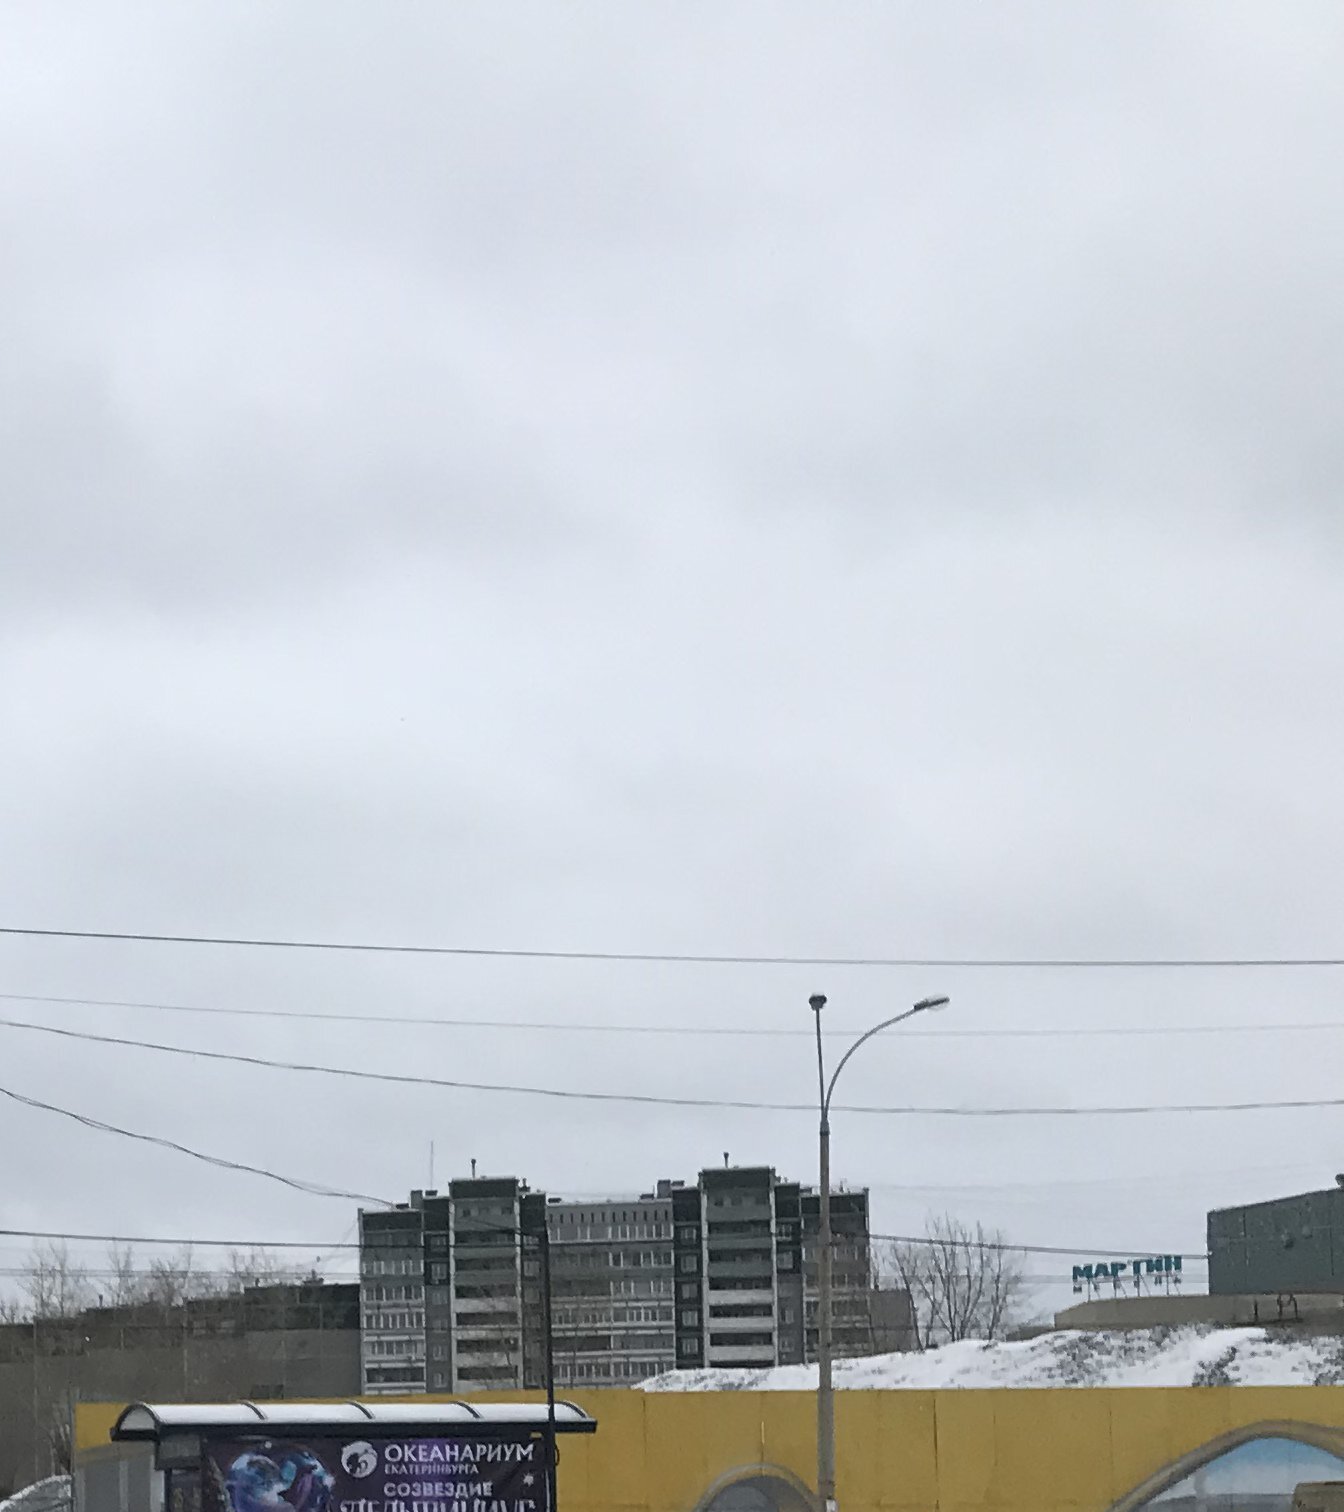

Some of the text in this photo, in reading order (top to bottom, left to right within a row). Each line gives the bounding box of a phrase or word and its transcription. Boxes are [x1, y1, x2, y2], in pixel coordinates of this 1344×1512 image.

[384, 1443, 534, 1463] ОКЕАНАРИУМ
[384, 1463, 480, 1475] ЕКАТЕРИНБУРГА
[383, 1481, 494, 1499] СОЗВЕЗДИЕ
